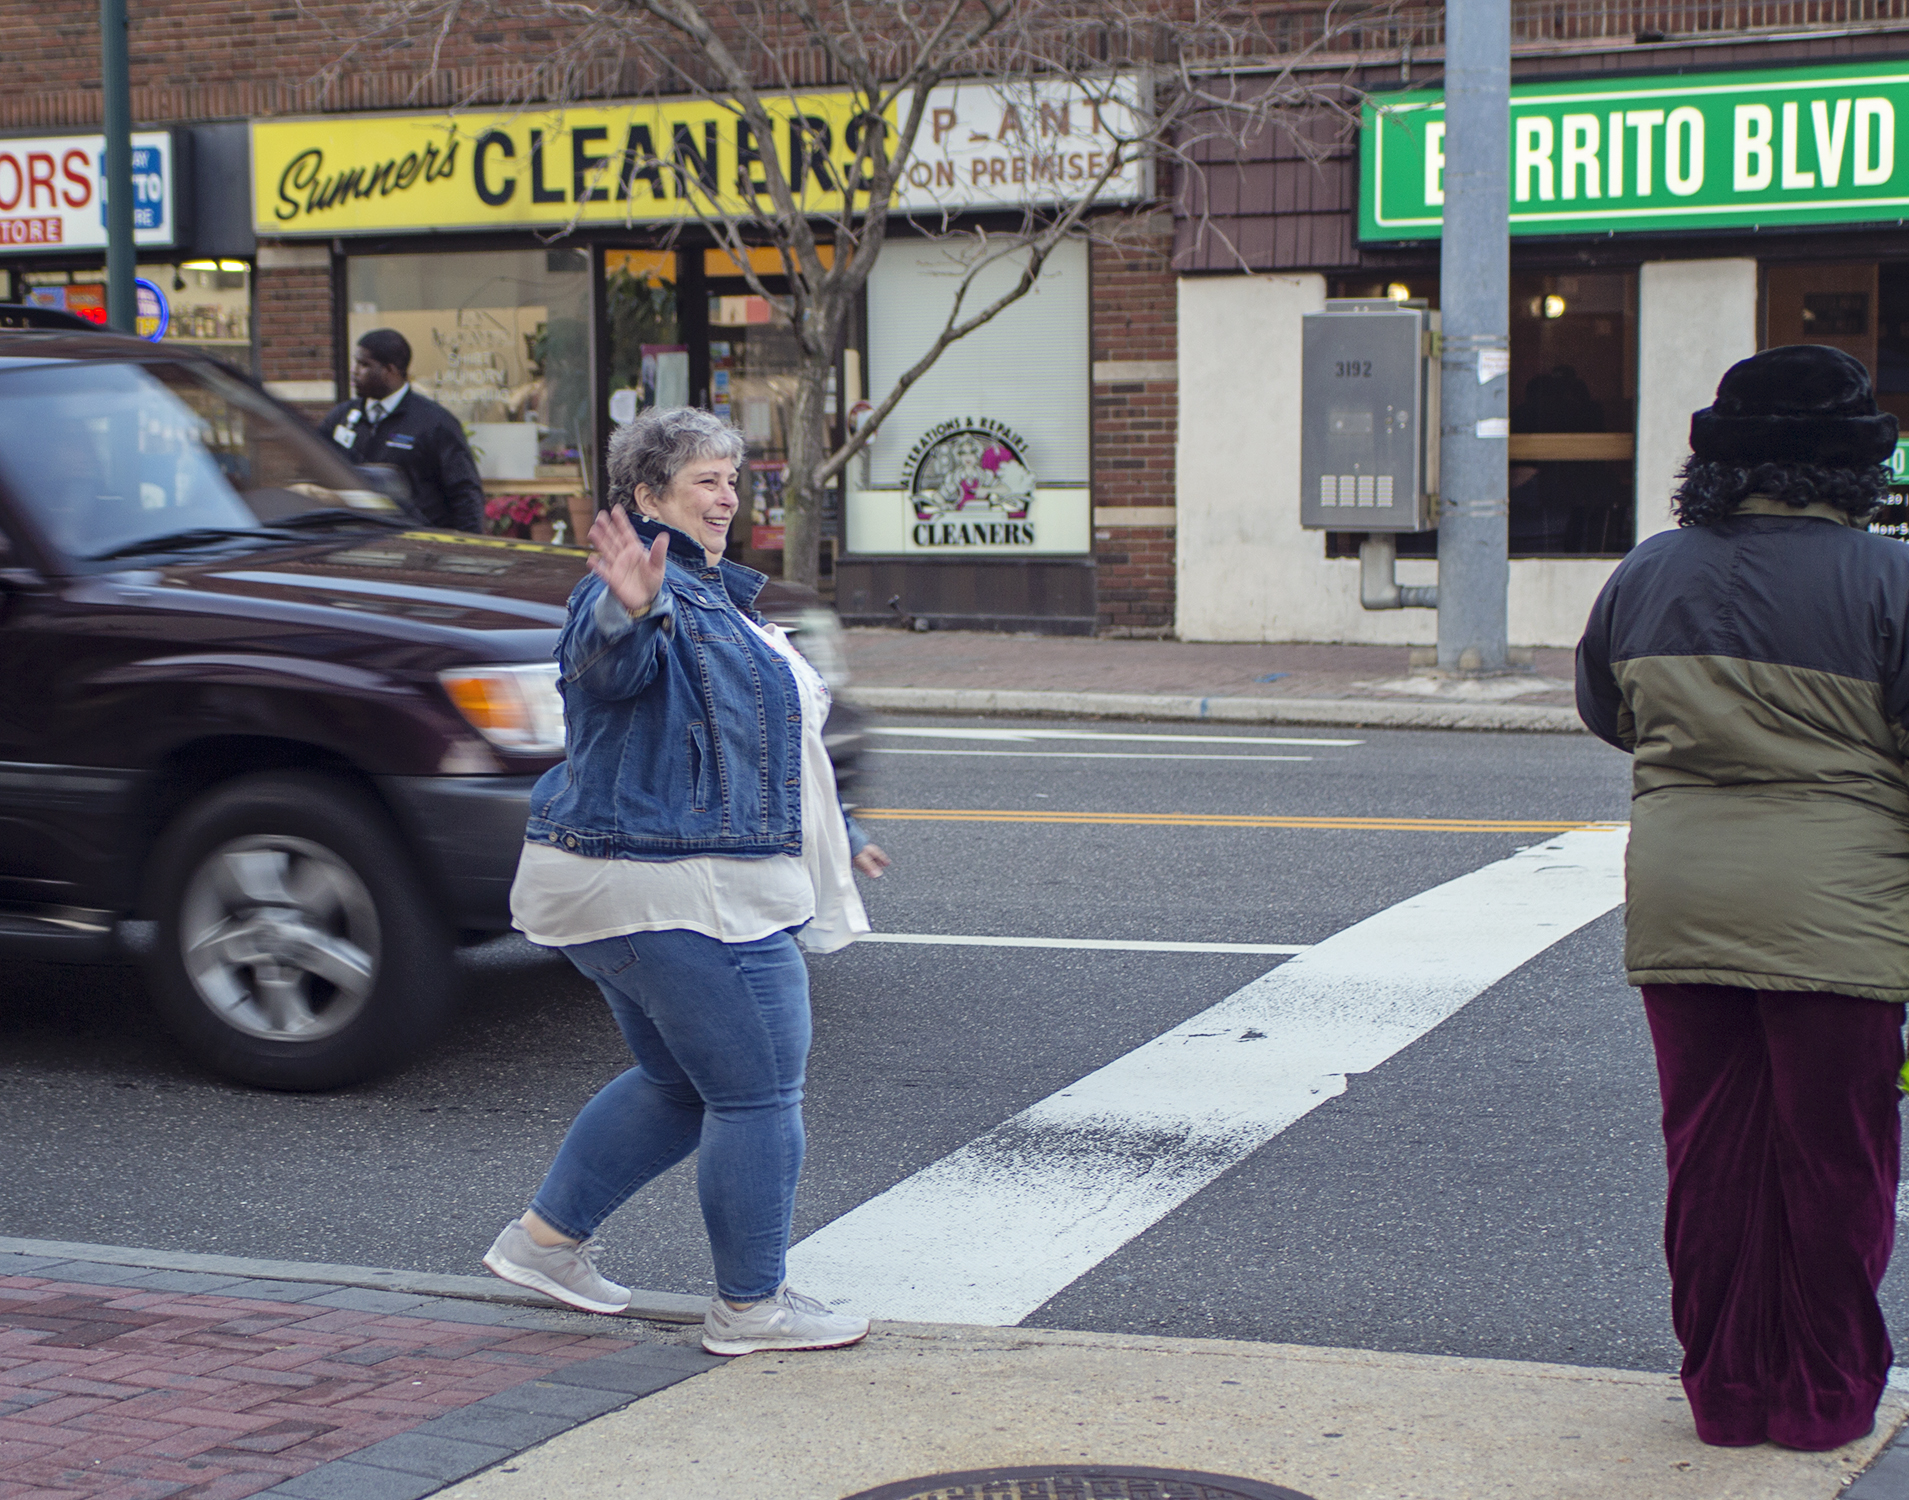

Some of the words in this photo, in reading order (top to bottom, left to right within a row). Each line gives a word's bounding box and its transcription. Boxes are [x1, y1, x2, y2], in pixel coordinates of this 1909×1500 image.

[275, 124, 460, 220] Sumner's
[473, 113, 890, 206] CLEANERS
[1733, 97, 1895, 192] BLVD
[908, 161, 954, 188] ON
[1335, 361, 1373, 378] 3192
[900, 417, 960, 488] ALTERATIONS
[980, 416, 1029, 454] REPAIRS
[912, 522, 1034, 546] CLEANERS
